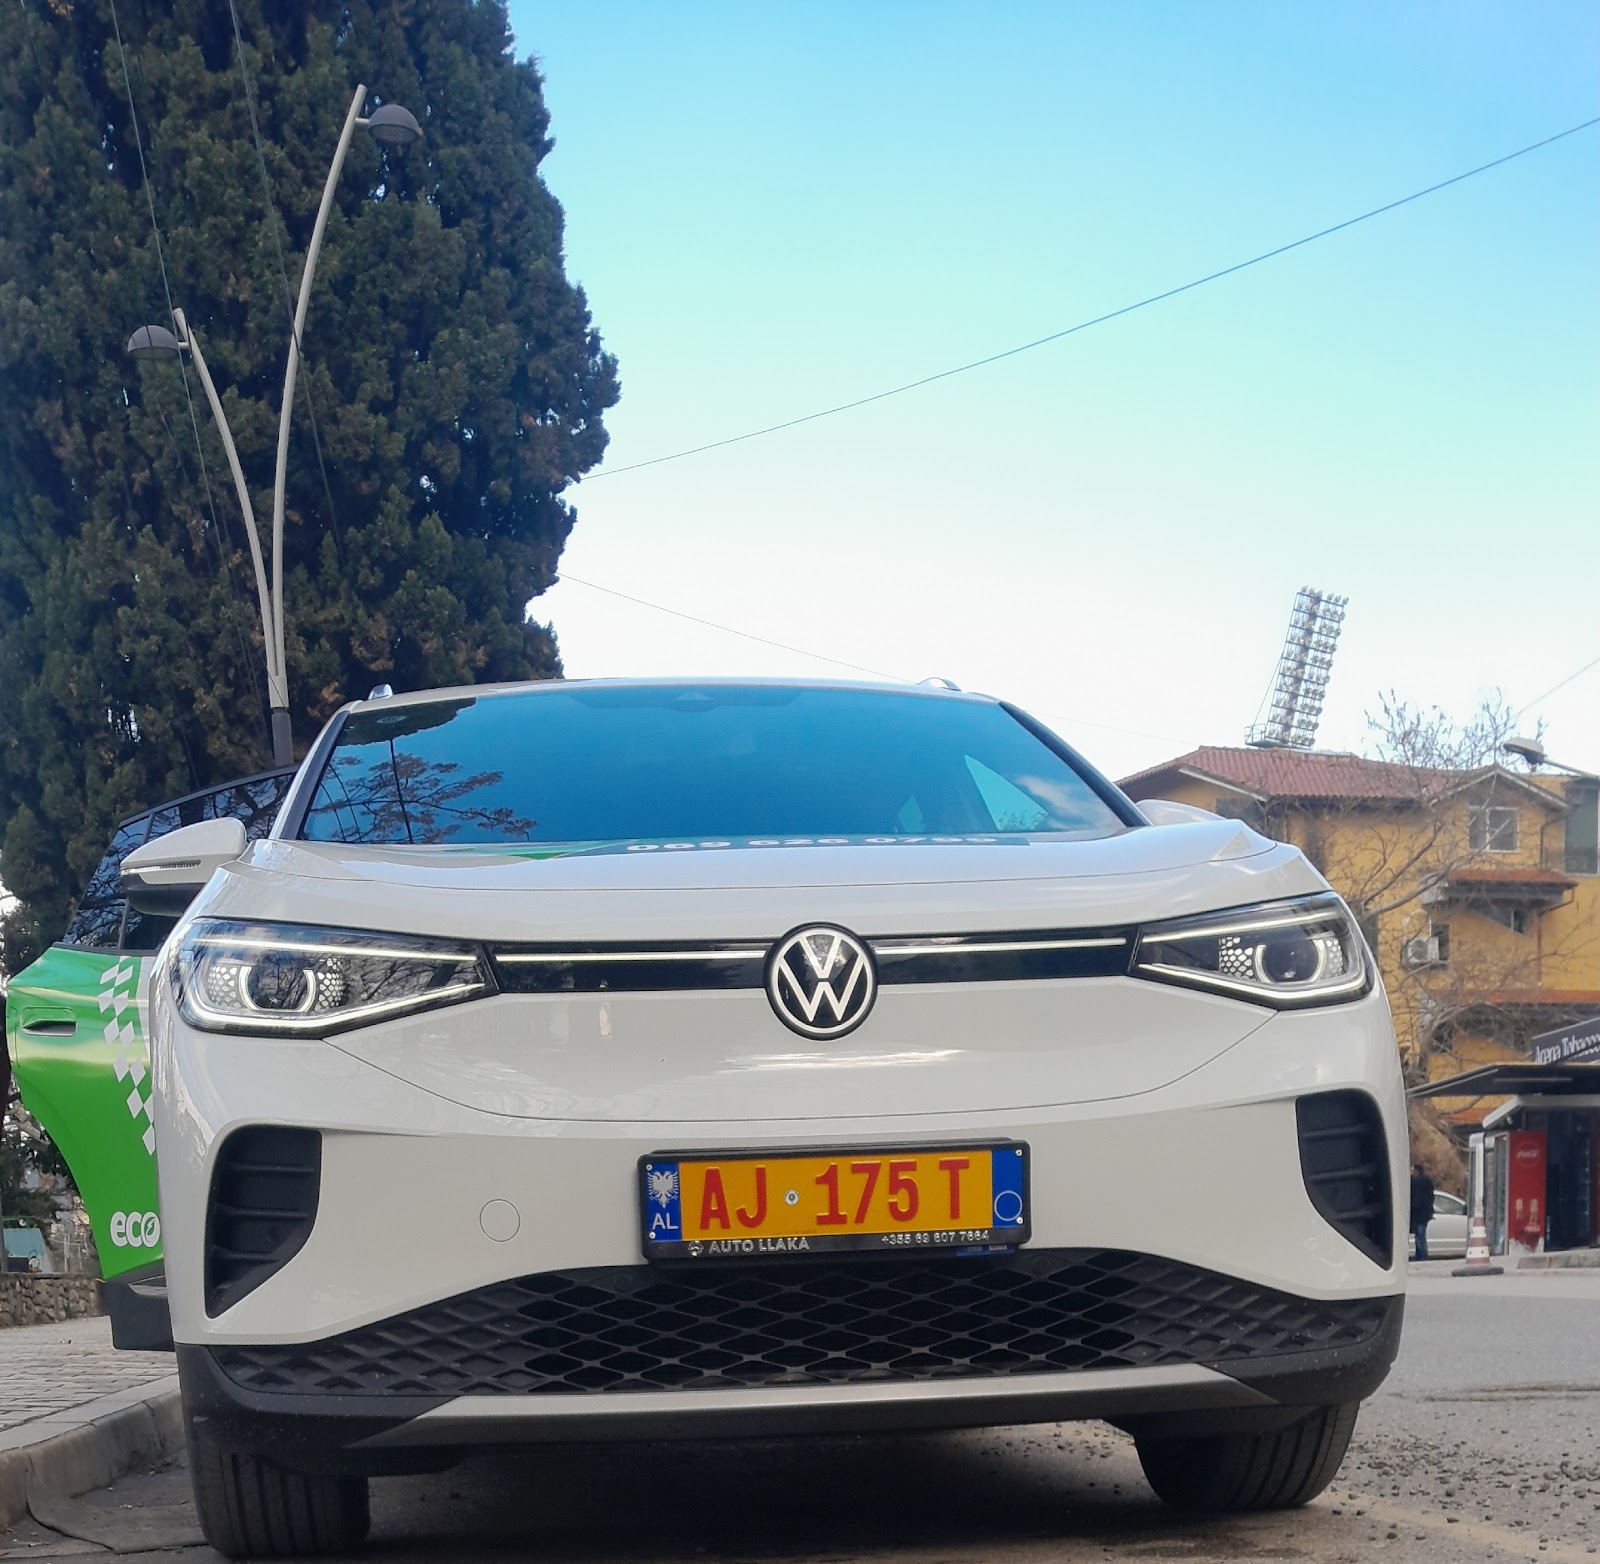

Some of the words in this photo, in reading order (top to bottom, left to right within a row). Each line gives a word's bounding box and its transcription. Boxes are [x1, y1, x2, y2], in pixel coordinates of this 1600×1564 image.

[699, 1164, 768, 1230] AJ
[815, 1158, 919, 1226] 175
[938, 1157, 970, 1220] T
[652, 1212, 679, 1231] AL
[708, 1239, 755, 1255] AUTO
[758, 1237, 811, 1252] LLAKA
